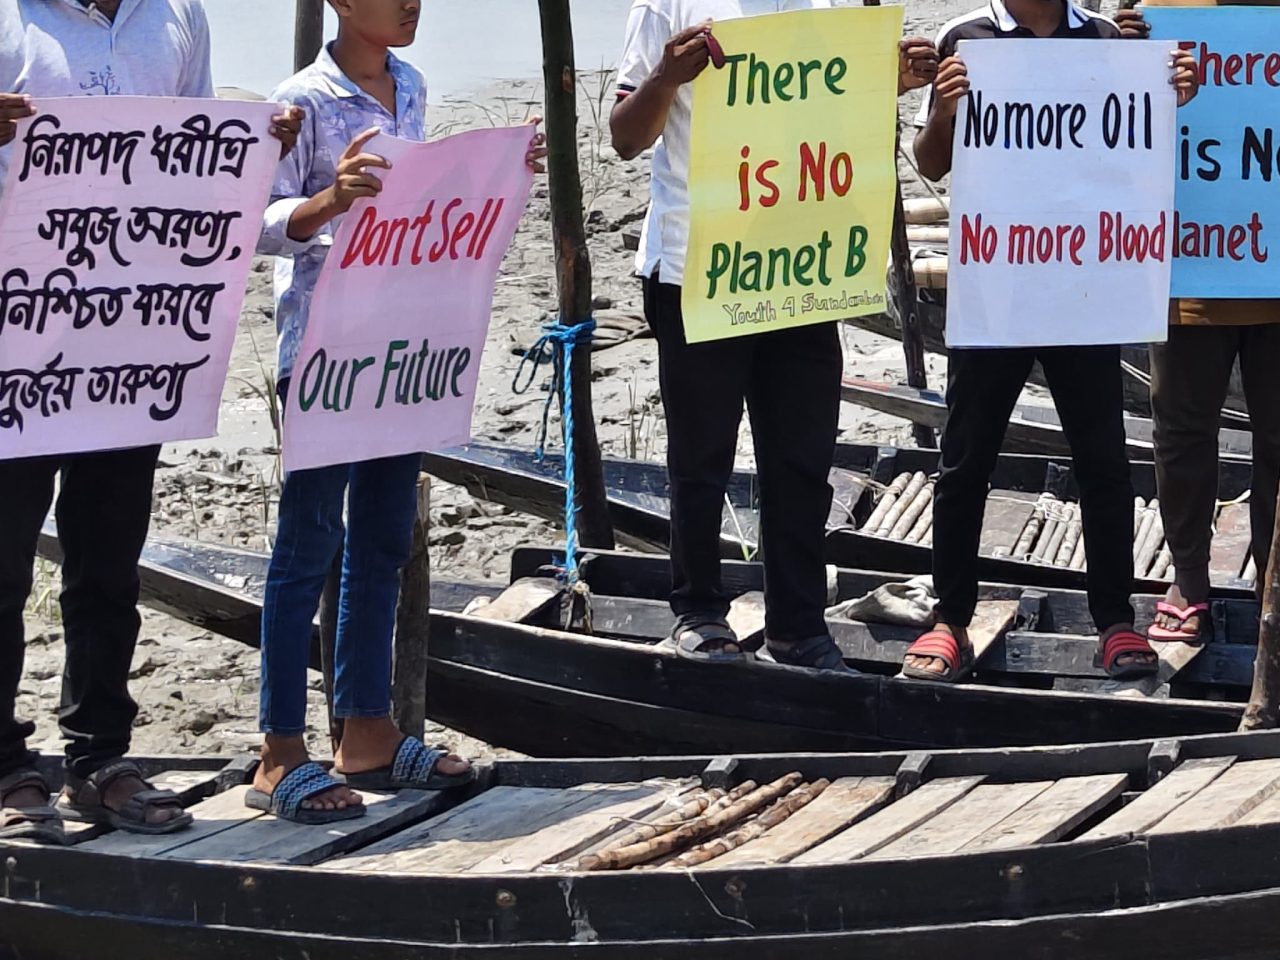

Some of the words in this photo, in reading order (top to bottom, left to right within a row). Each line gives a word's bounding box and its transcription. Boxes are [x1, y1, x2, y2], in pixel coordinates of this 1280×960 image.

[724, 52, 847, 107] There
[19, 114, 145, 184] নিরাপদ
[151, 114, 259, 178] ধরীত্রি
[964, 90, 999, 149] No
[1004, 102, 1087, 150] more
[1102, 91, 1152, 150] Oil
[738, 145, 780, 212] is
[798, 141, 853, 202] No
[1180, 125, 1222, 181] is
[38, 206, 131, 270] সবুজ
[127, 206, 242, 267] অরণ্য,
[428, 198, 504, 263] Sell
[706, 230, 832, 299] Planet
[844, 225, 868, 277] B
[960, 213, 998, 265] No
[1008, 224, 1085, 266] more
[1099, 211, 1166, 263] Blood
[1172, 211, 1268, 263] lanet
[0, 268, 132, 335] নিশ্চিত
[133, 283, 225, 341] করবে
[722, 300, 777, 326] Youth
[87, 354, 210, 421] তারুণ্য
[299, 347, 376, 412] Our
[374, 338, 471, 409] Future
